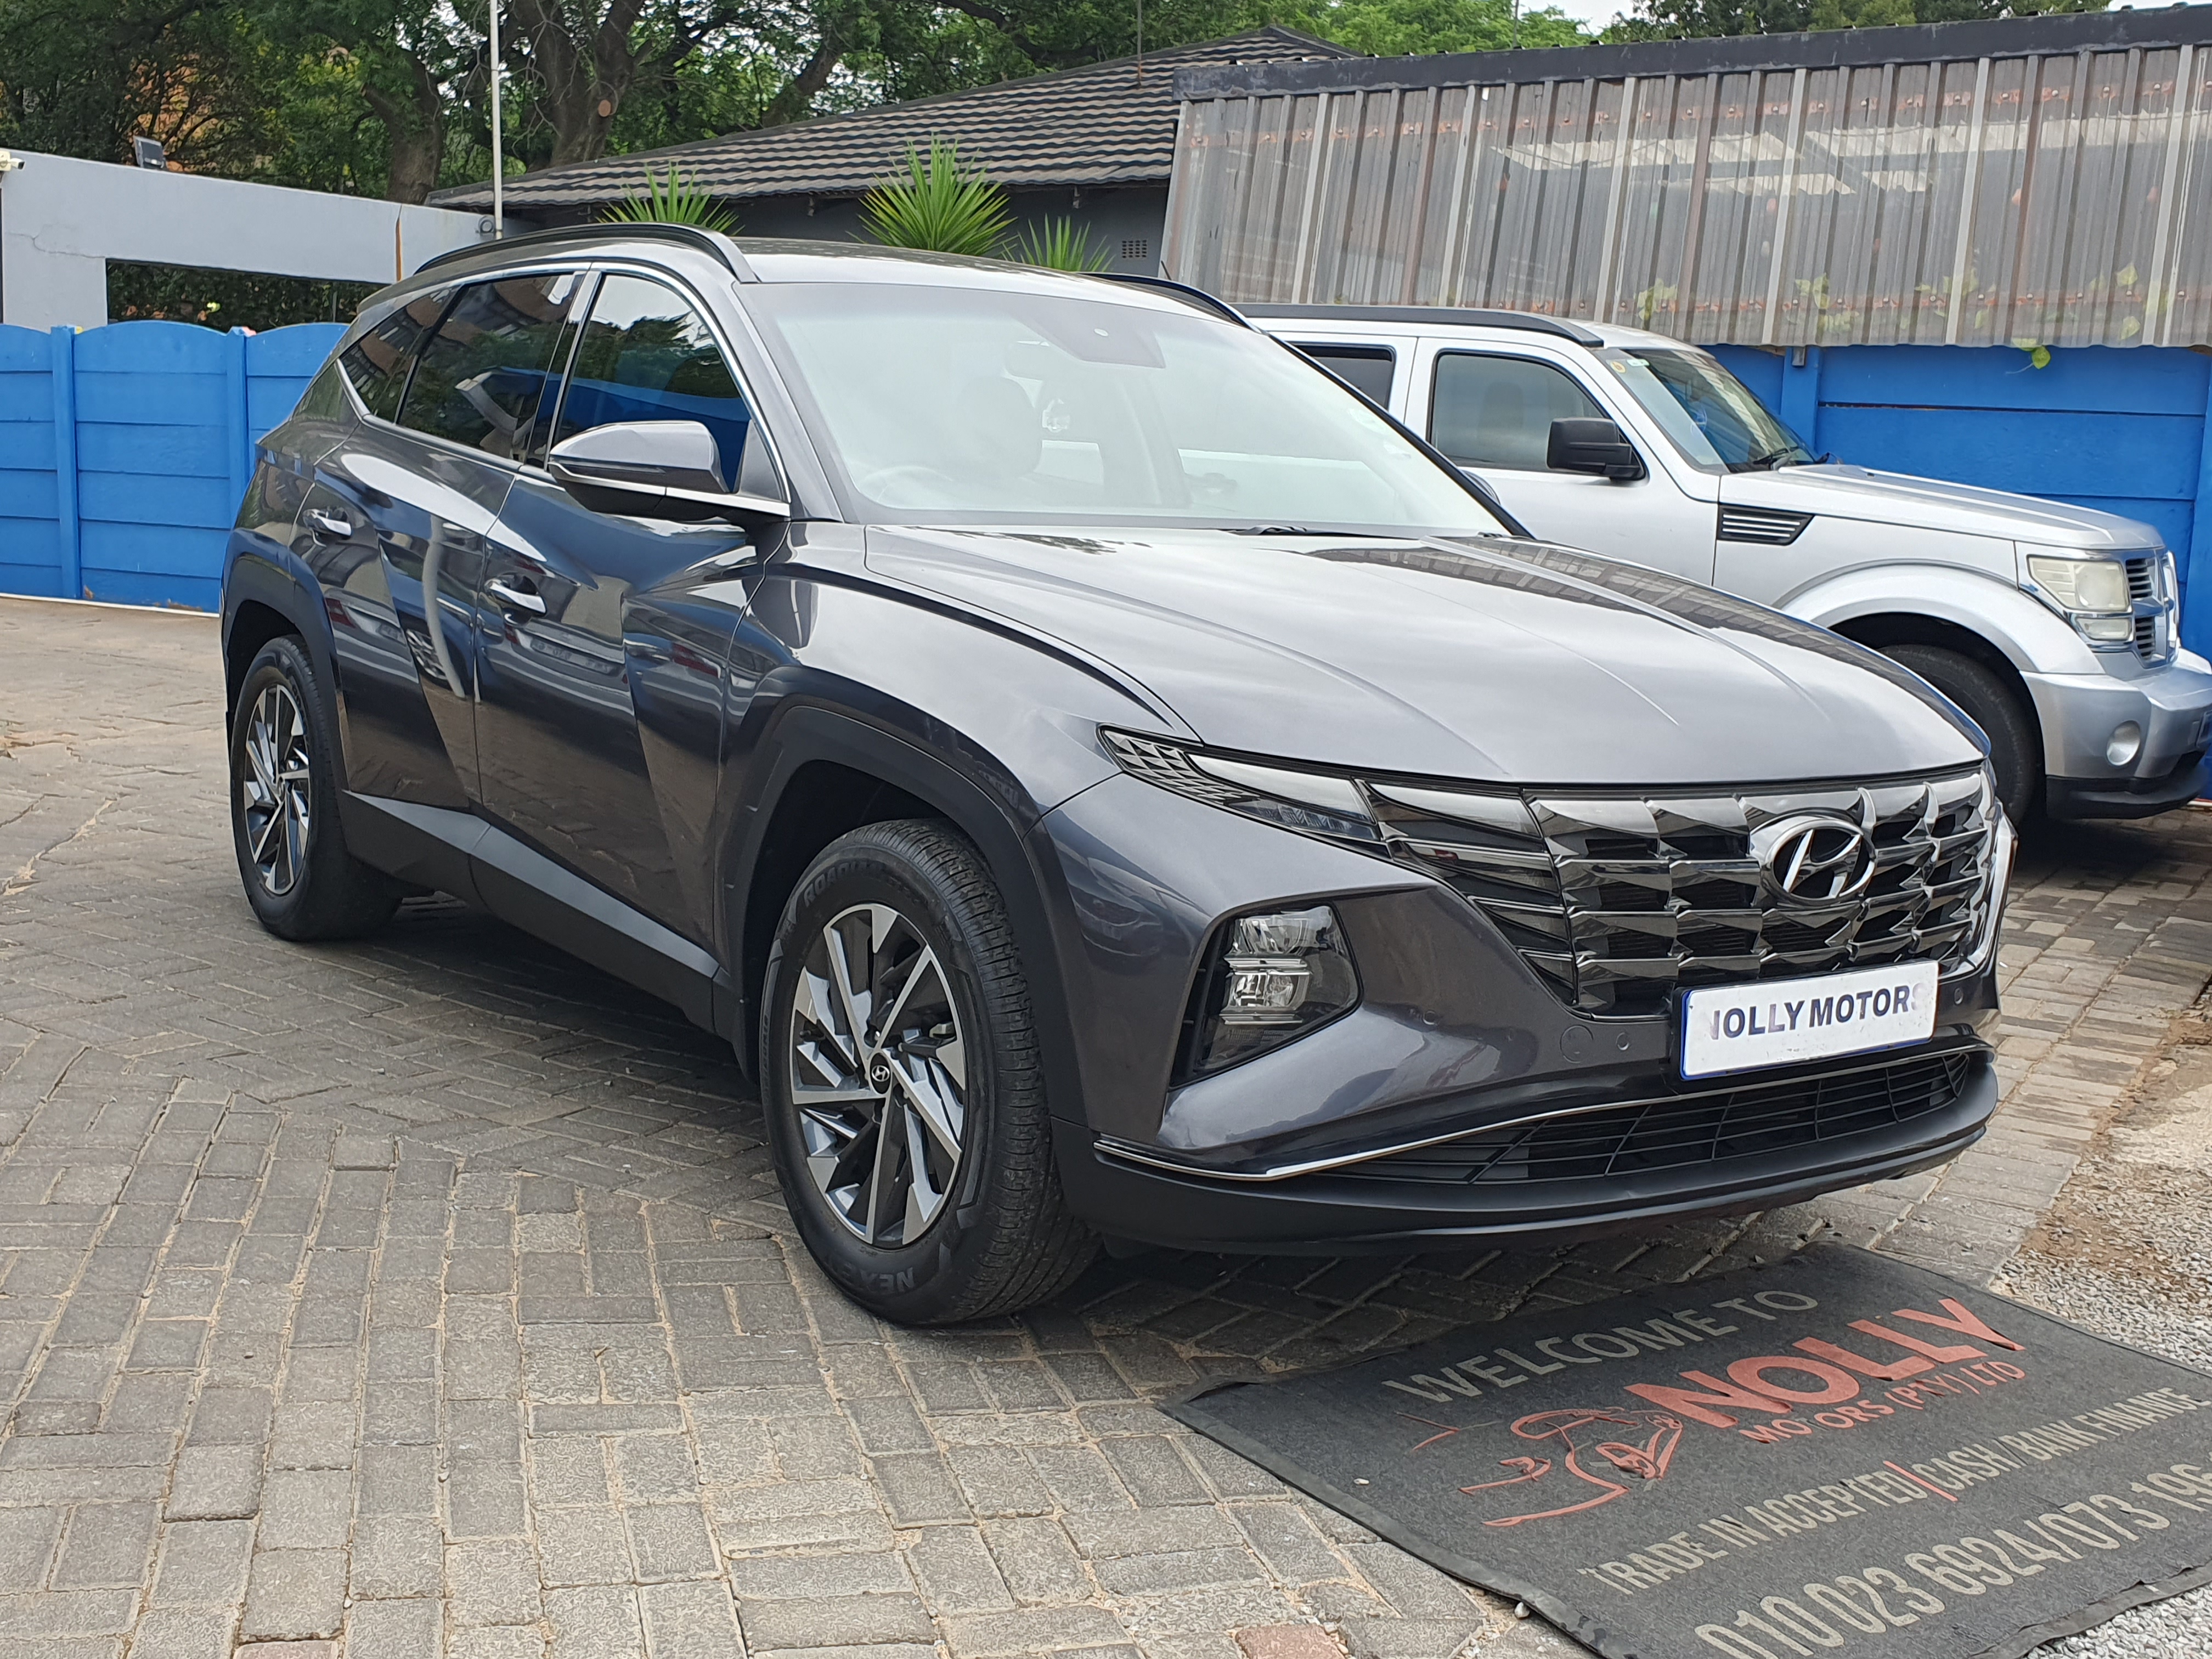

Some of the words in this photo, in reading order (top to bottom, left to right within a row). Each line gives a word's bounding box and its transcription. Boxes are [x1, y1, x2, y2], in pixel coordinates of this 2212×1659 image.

[1381, 1309, 1740, 1402] WELCOME
[1711, 1290, 1819, 1321] TO
[1624, 1298, 2026, 1428] NOLLY
[1884, 1373, 1980, 1410] (PTY)
[1959, 1361, 2026, 1387] LTD
[1576, 1531, 1729, 1594] TRADE
[1697, 1514, 1770, 1548] IN
[2072, 1387, 2212, 1437] FINANCE
[1694, 1595, 1845, 1659] 010
[1803, 1567, 1946, 1634] 023
